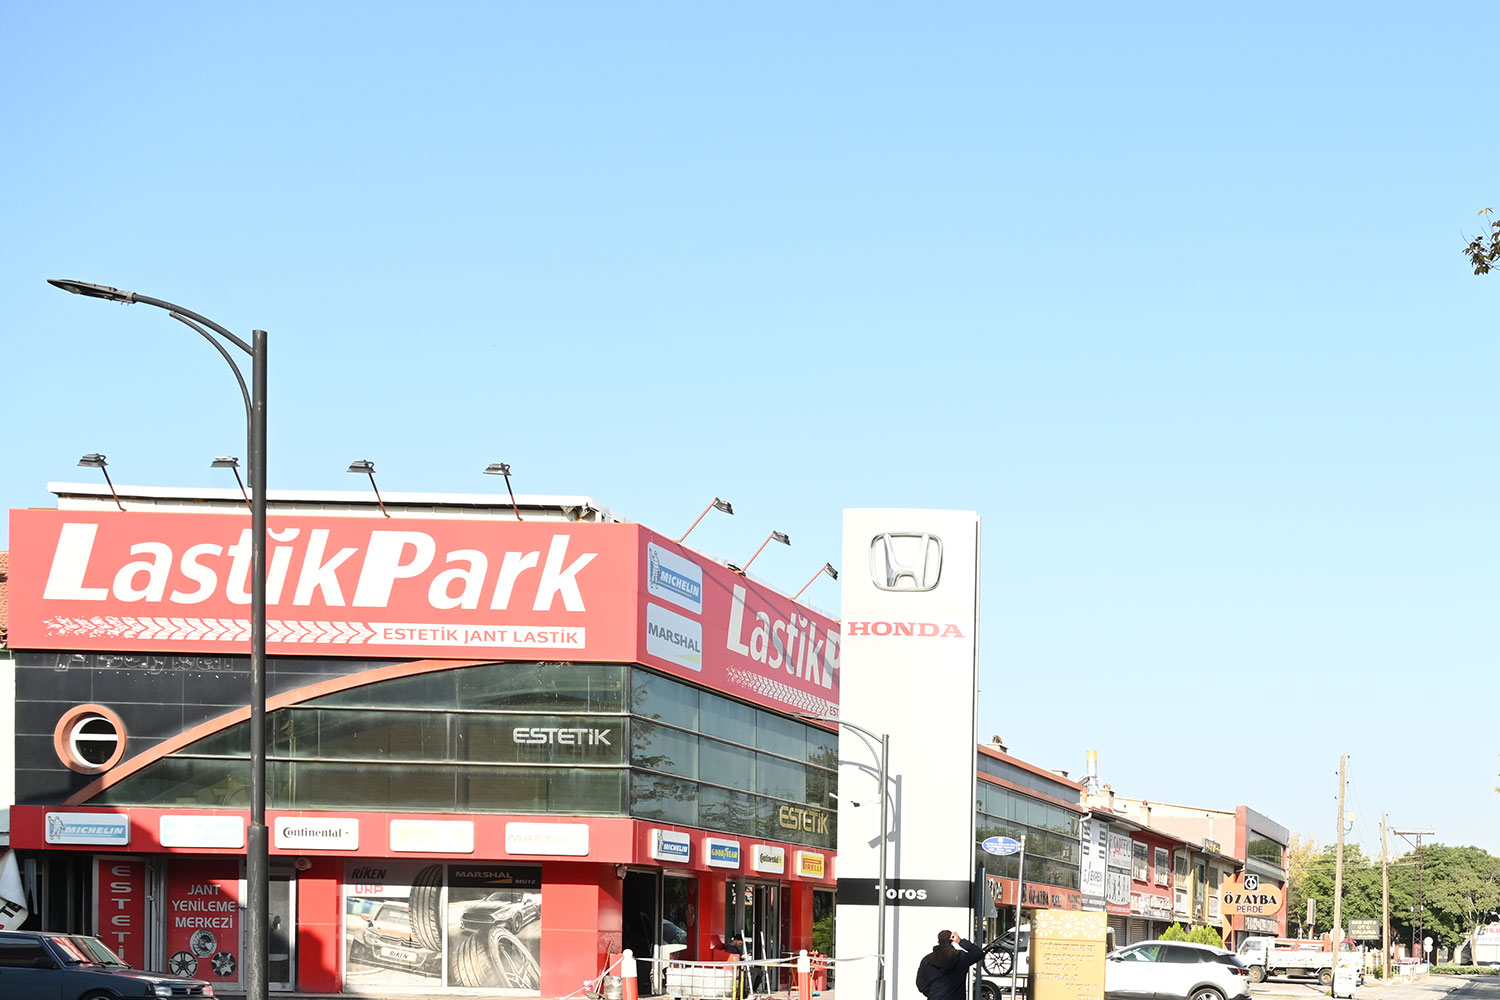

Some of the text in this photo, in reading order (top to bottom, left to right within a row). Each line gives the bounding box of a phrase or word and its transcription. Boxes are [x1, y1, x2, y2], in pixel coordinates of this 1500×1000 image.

[659, 570, 700, 598] MICHELIN
[383, 626, 579, 645] ESTETİK JANT LASTİK
[726, 583, 840, 690] LastikP
[847, 621, 966, 638] HONDA
[648, 622, 701, 653] MARSHAL
[64, 826, 124, 835] MICHELIN
[282, 826, 342, 839] Continental
[663, 843, 688, 853] MICHELIN
[711, 847, 738, 860] GOODYEAR
[802, 857, 822, 872] PIRELLI
[455, 871, 513, 879] MARSHAL
[187, 884, 221, 896] JANT
[875, 884, 928, 900] oros
[172, 898, 236, 912] YENİLEME
[1223, 891, 1277, 905] ÖZAYBA
[110, 865, 132, 959] ESTETİ
[1236, 905, 1264, 914] PERDE
[175, 914, 233, 929] MERKEZİ
